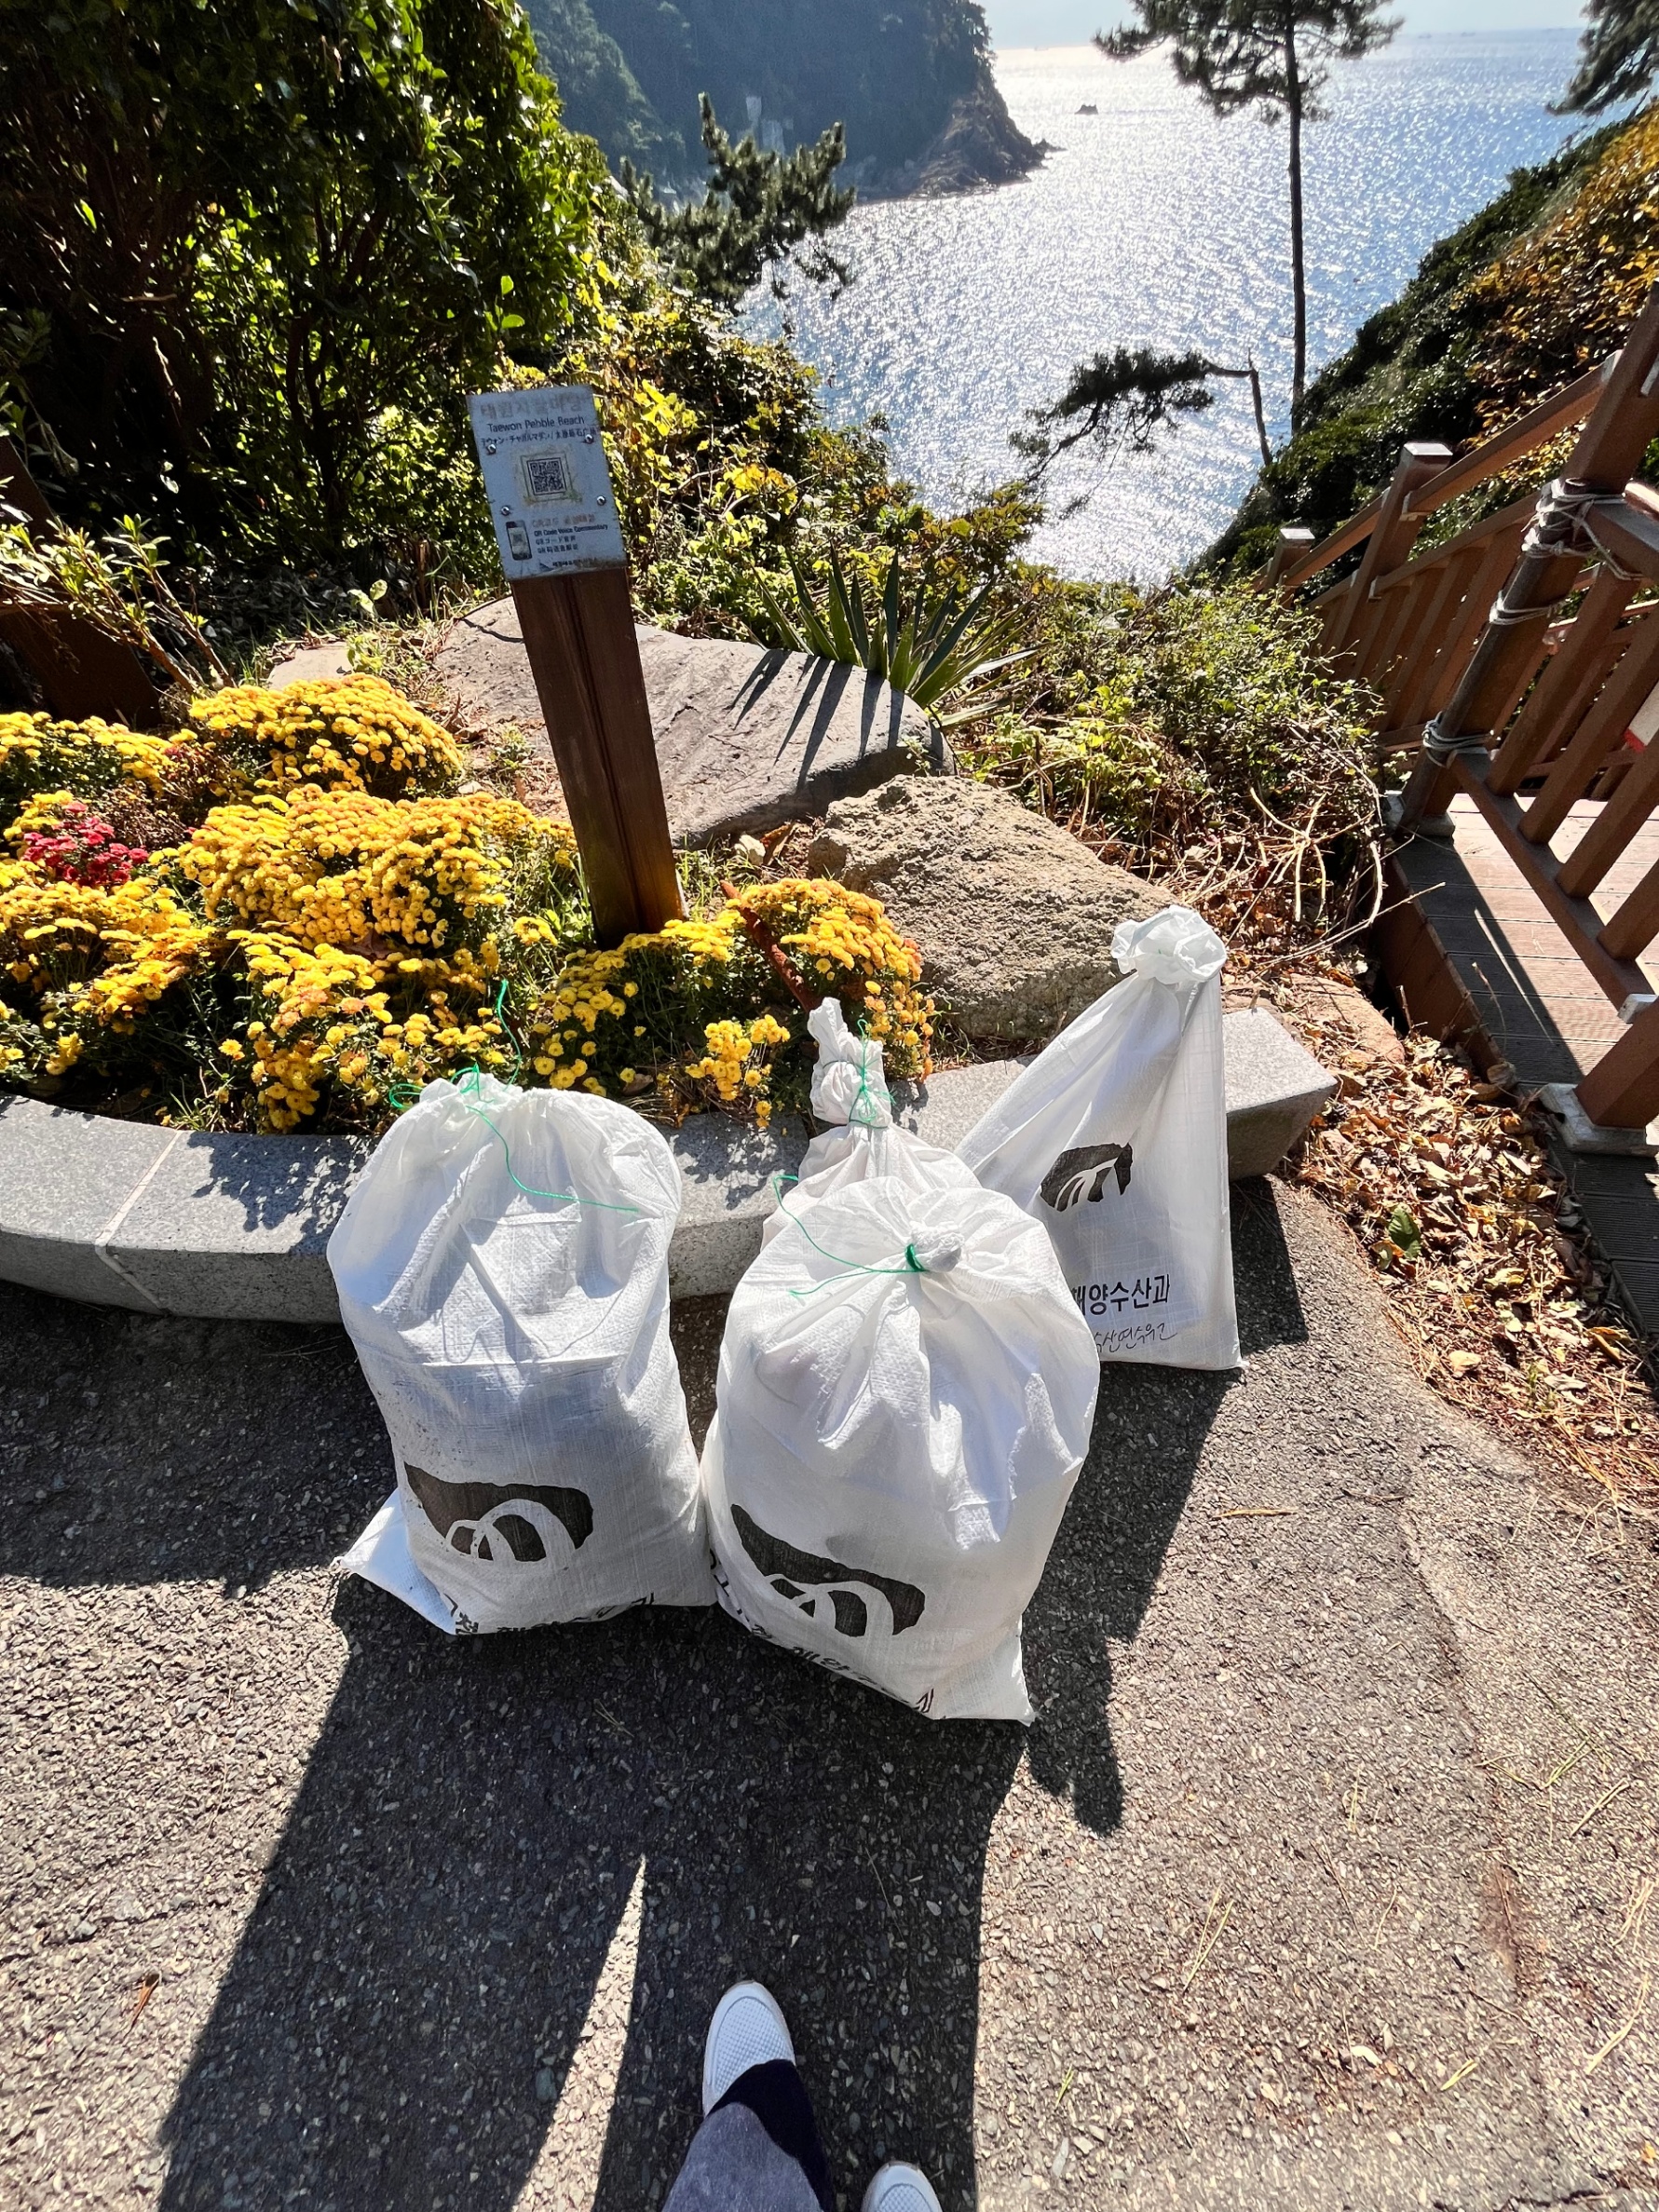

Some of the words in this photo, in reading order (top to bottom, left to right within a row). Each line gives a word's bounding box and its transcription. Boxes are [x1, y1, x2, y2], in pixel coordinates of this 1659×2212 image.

[487, 422, 522, 433] Taewon
[524, 416, 555, 428] Pebble
[558, 414, 585, 427] Beach
